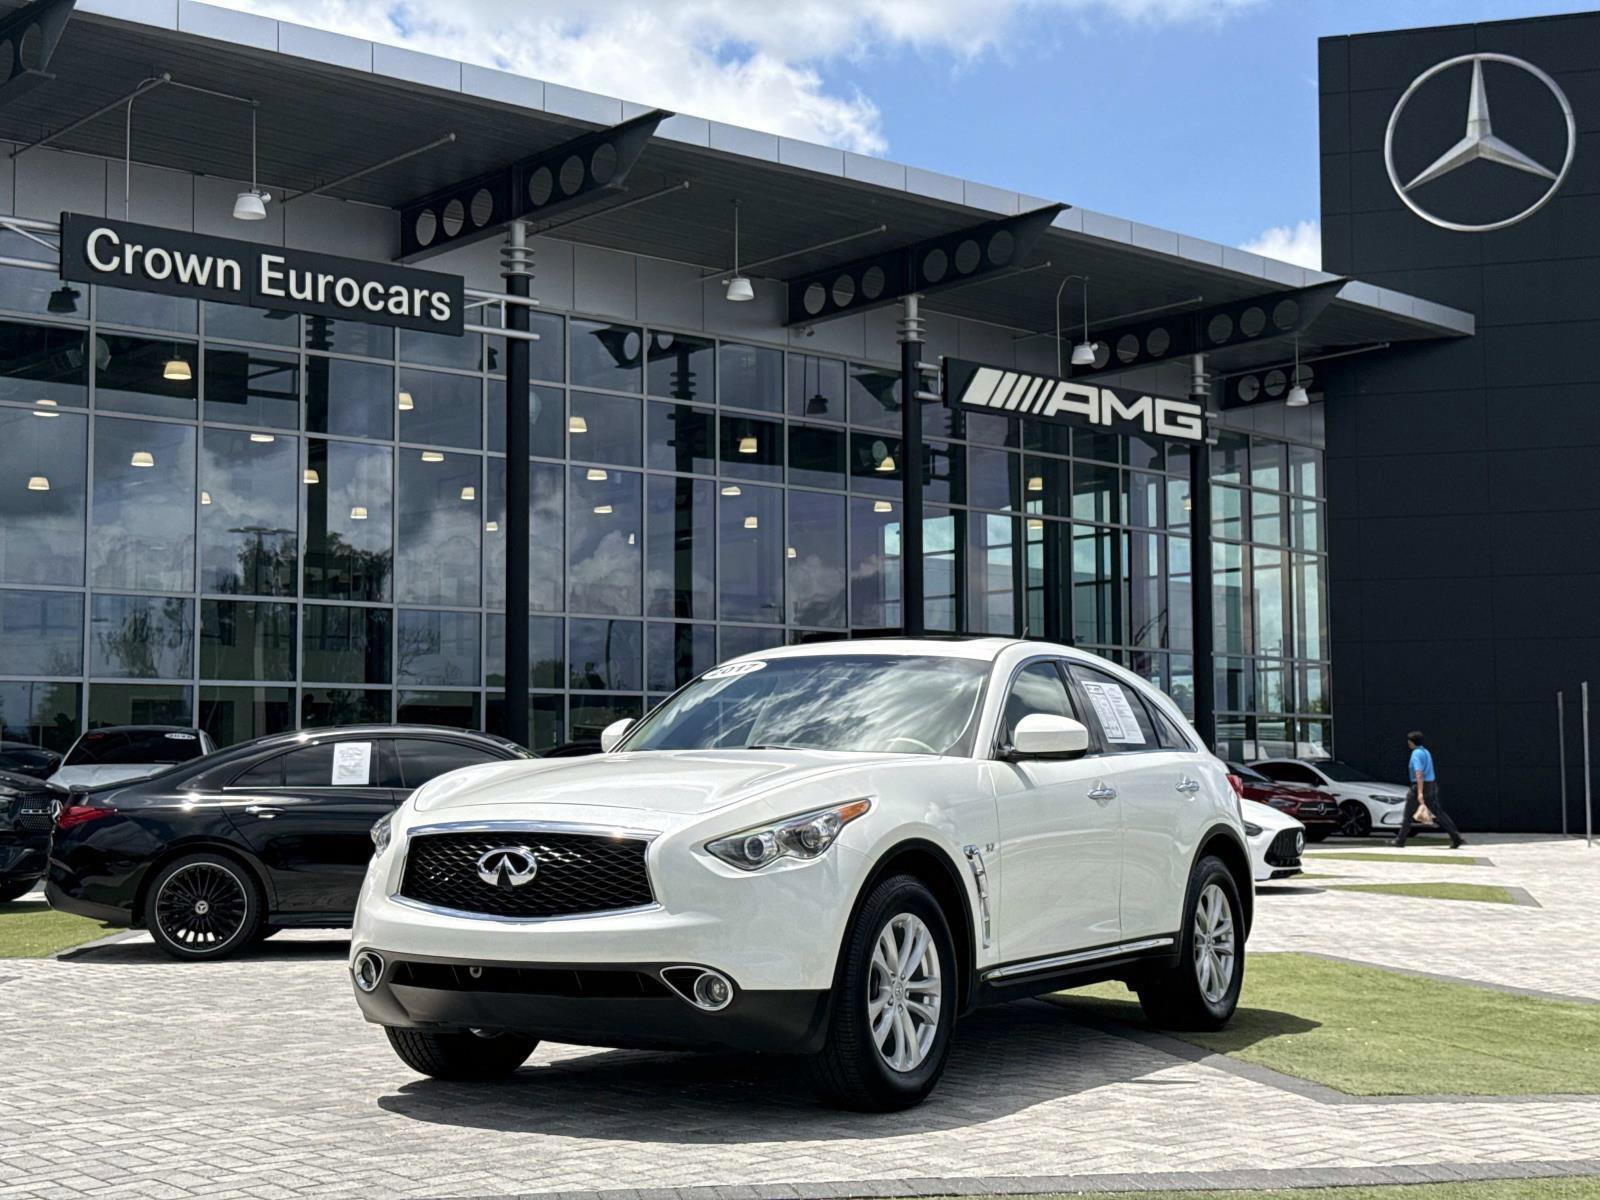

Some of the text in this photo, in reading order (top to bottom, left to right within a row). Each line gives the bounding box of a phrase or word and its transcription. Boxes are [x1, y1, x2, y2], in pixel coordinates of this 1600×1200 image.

[86, 227, 452, 321] Crown Eurocars
[1043, 381, 1203, 440] AMG
